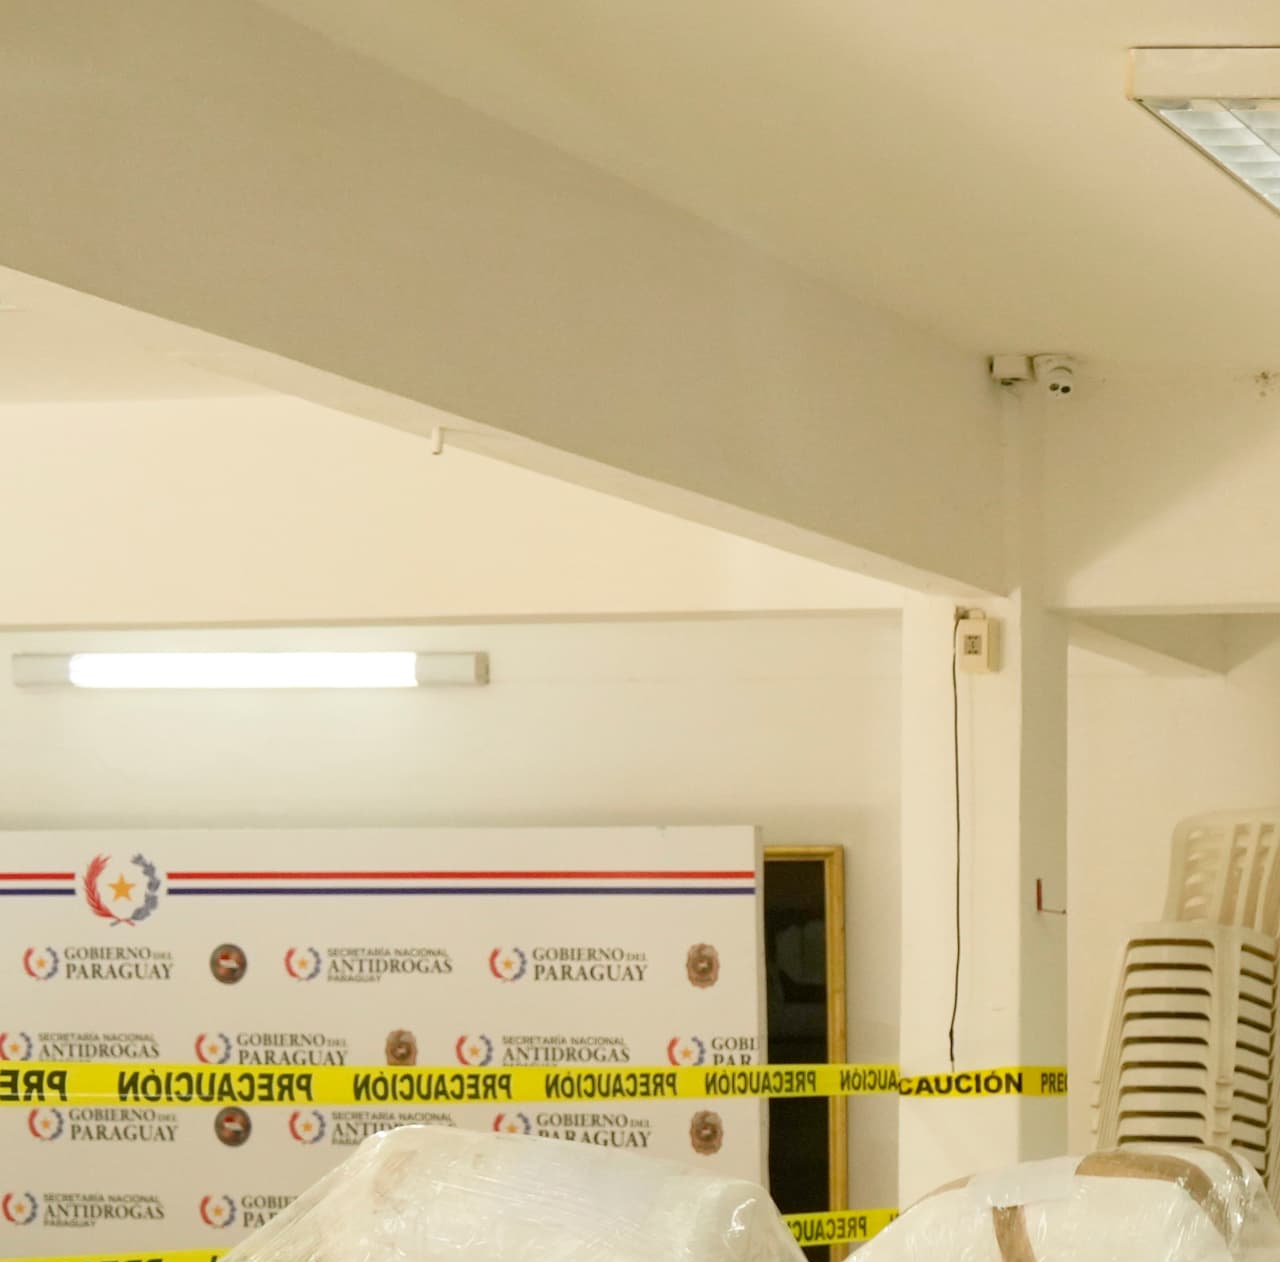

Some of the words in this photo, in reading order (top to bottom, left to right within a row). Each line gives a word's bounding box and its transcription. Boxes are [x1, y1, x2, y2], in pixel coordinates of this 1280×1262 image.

[64, 946, 152, 960] GOBIERNO
[532, 947, 625, 961] GOBIERNO
[65, 963, 174, 980] PARAGUAY
[328, 959, 453, 973] ANTIDROGAS
[534, 964, 648, 981] PARAGUAY
[236, 1033, 326, 1047] GOBIERNO
[39, 1043, 160, 1058] ANTIDROGAS
[503, 1047, 631, 1062] ANTIDROGAS
[69, 1108, 156, 1121] GOBIERNO
[536, 1113, 629, 1128] GOBIERNO
[70, 1124, 178, 1141] PARAGUAY
[44, 1204, 165, 1219] ANTIDROGAS
